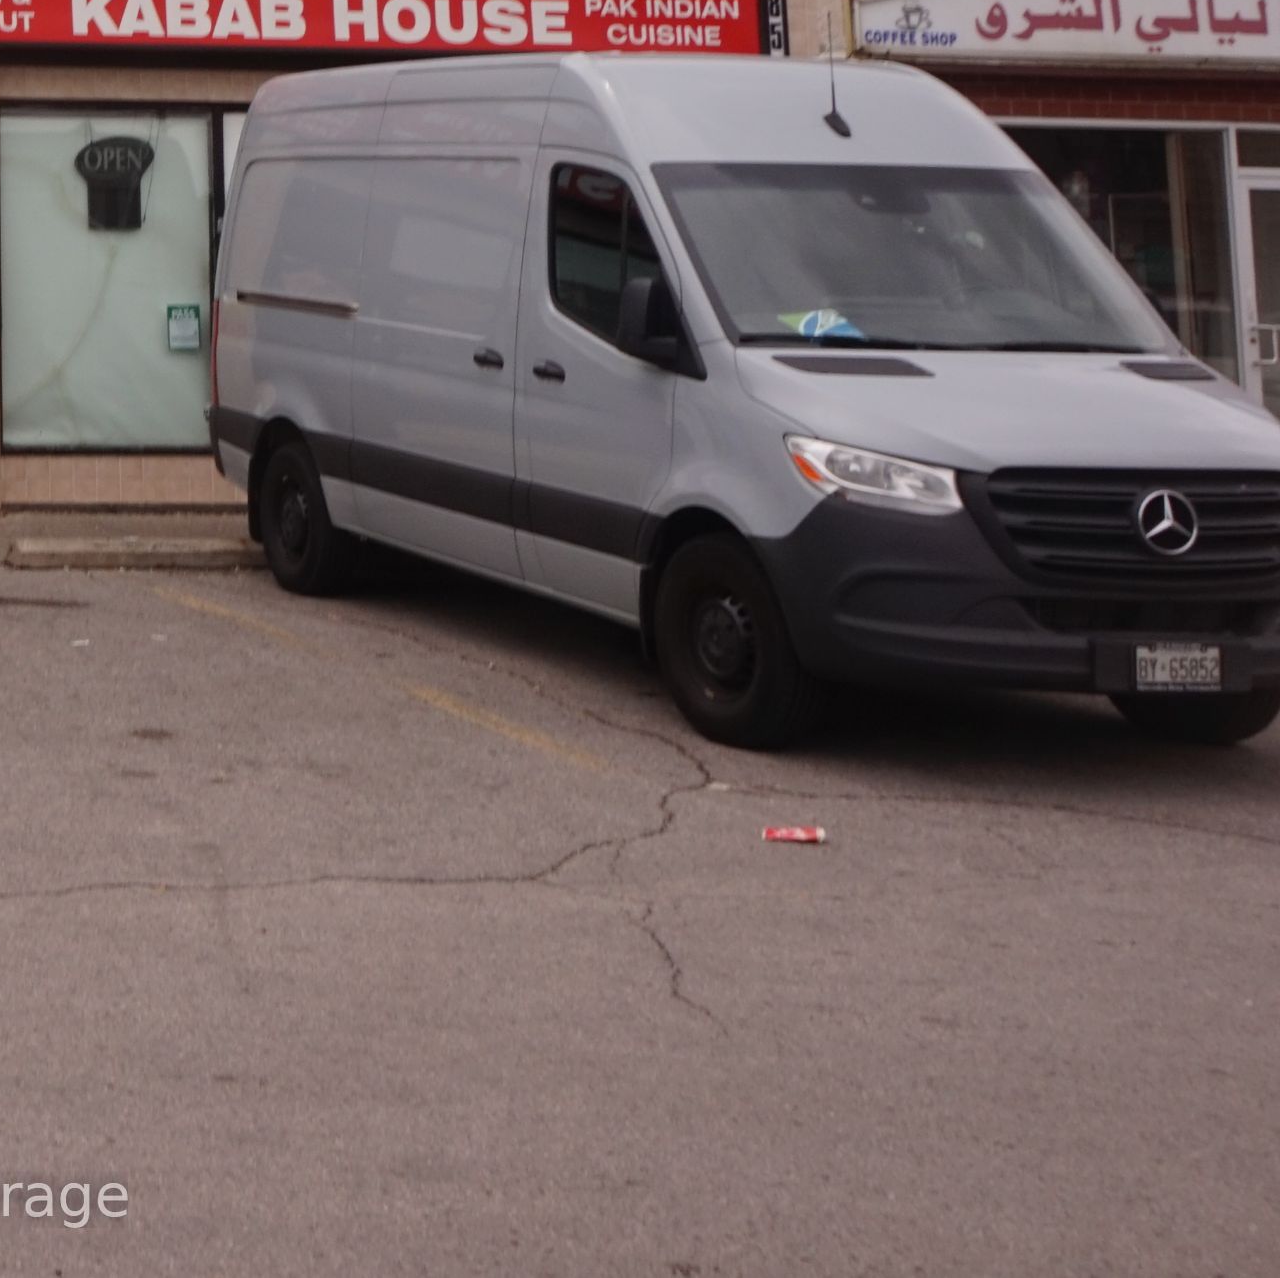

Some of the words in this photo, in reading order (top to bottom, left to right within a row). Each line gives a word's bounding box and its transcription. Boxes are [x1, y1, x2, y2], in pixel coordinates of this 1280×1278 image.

[606, 23, 722, 47] CUISINE
[865, 30, 916, 45] COFFEE
[922, 31, 958, 47] SHOP
[83, 145, 142, 171] OPEN
